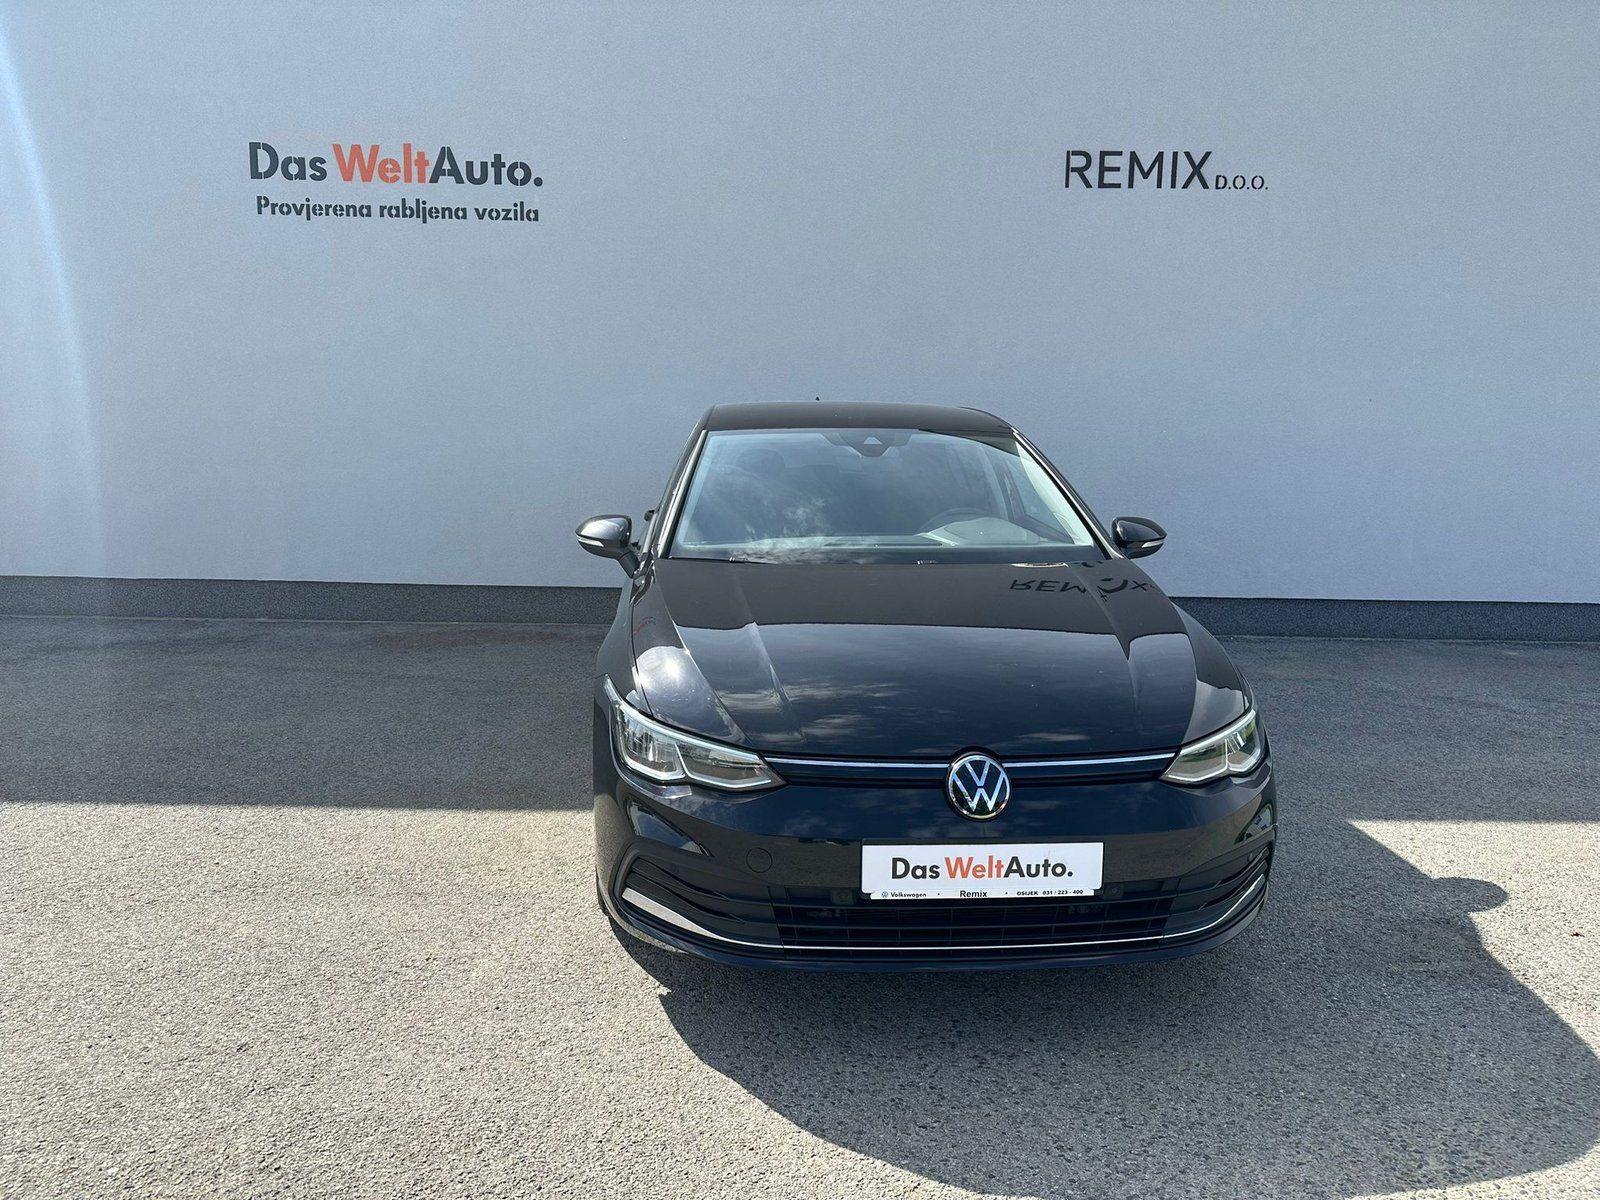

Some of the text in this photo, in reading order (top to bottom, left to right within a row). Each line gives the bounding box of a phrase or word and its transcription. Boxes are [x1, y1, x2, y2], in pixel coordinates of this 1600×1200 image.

[249, 141, 543, 187] Das WeltAuto.
[1065, 150, 1269, 190] REMIX D.O.O.
[256, 195, 539, 223] Provjerena rabljena vozila
[891, 855, 1073, 880] Das WeltAuto.
[959, 889, 988, 898] Remix
